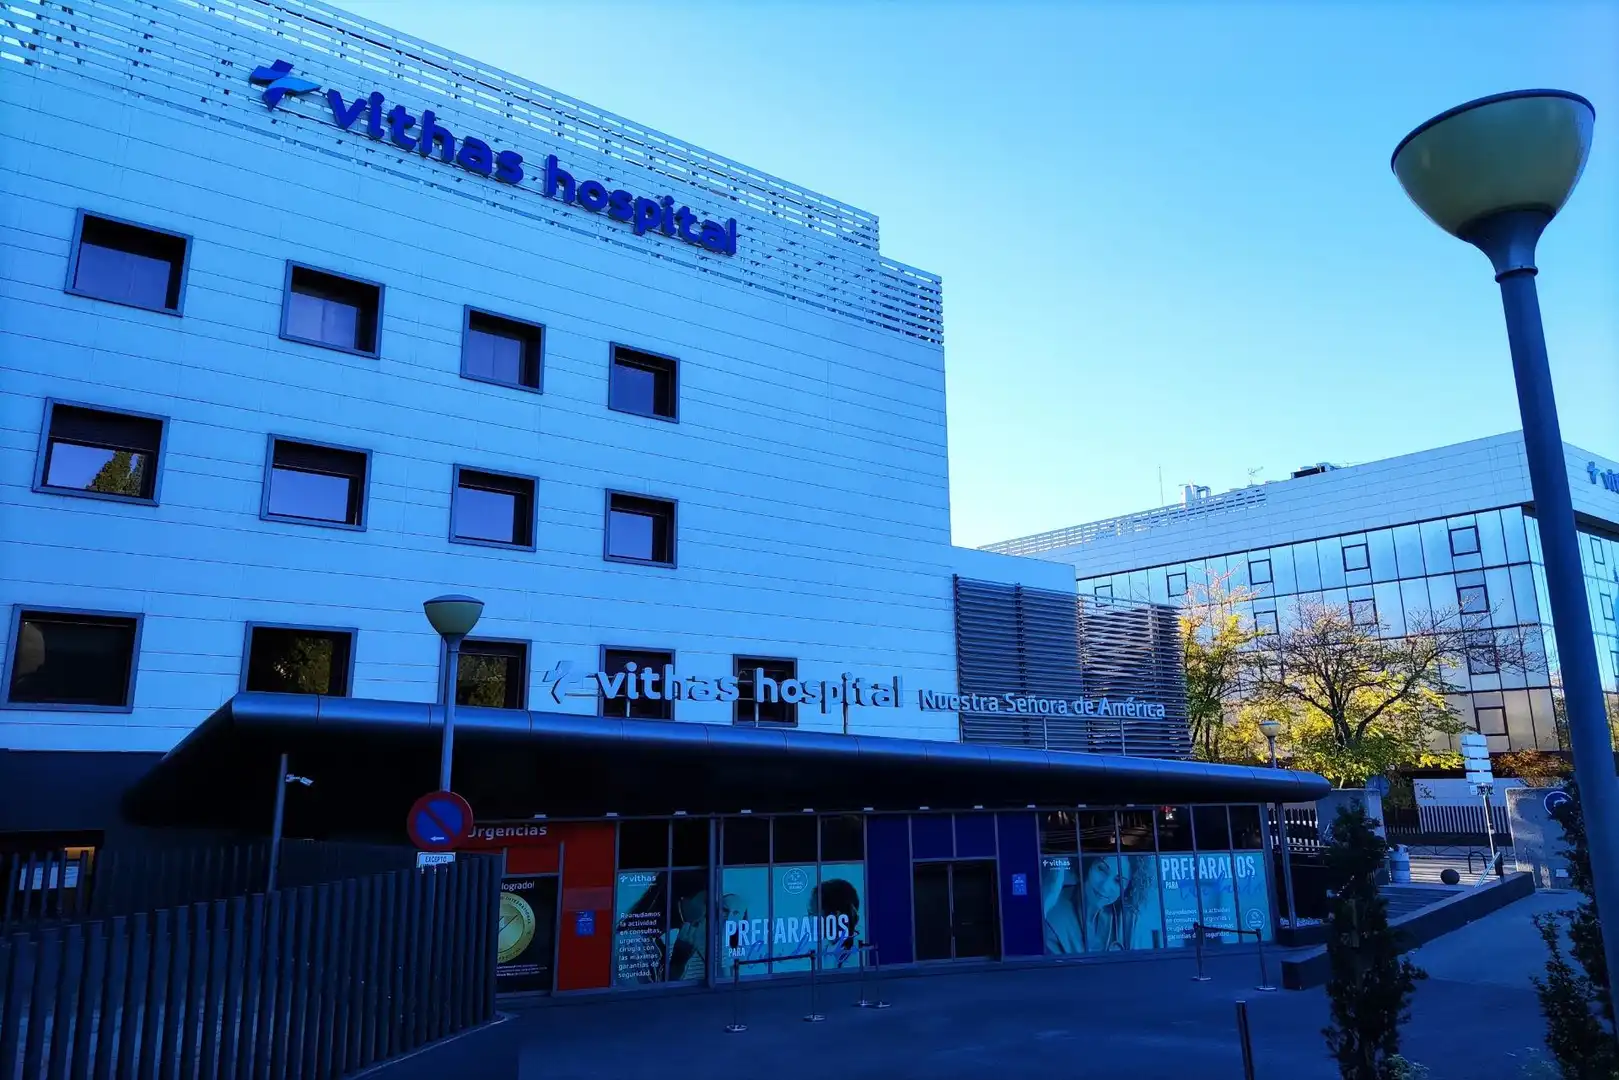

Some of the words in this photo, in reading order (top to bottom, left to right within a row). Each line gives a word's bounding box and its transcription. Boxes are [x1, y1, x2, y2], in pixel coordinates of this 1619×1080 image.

[327, 88, 524, 184] vithas
[544, 154, 738, 257] hospital
[598, 661, 740, 702] vithas
[756, 667, 904, 715] hospital
[919, 689, 999, 713] Nuestra
[1005, 691, 1068, 716] Señora
[1073, 696, 1094, 716] de
[1097, 696, 1166, 718] América
[425, 855, 447, 863] EXCEPTO
[629, 874, 657, 882] vithas
[501, 880, 535, 892] logrado!
[1165, 881, 1179, 890] PARA
[627, 919, 657, 927] actividad
[728, 947, 746, 958] PARA
